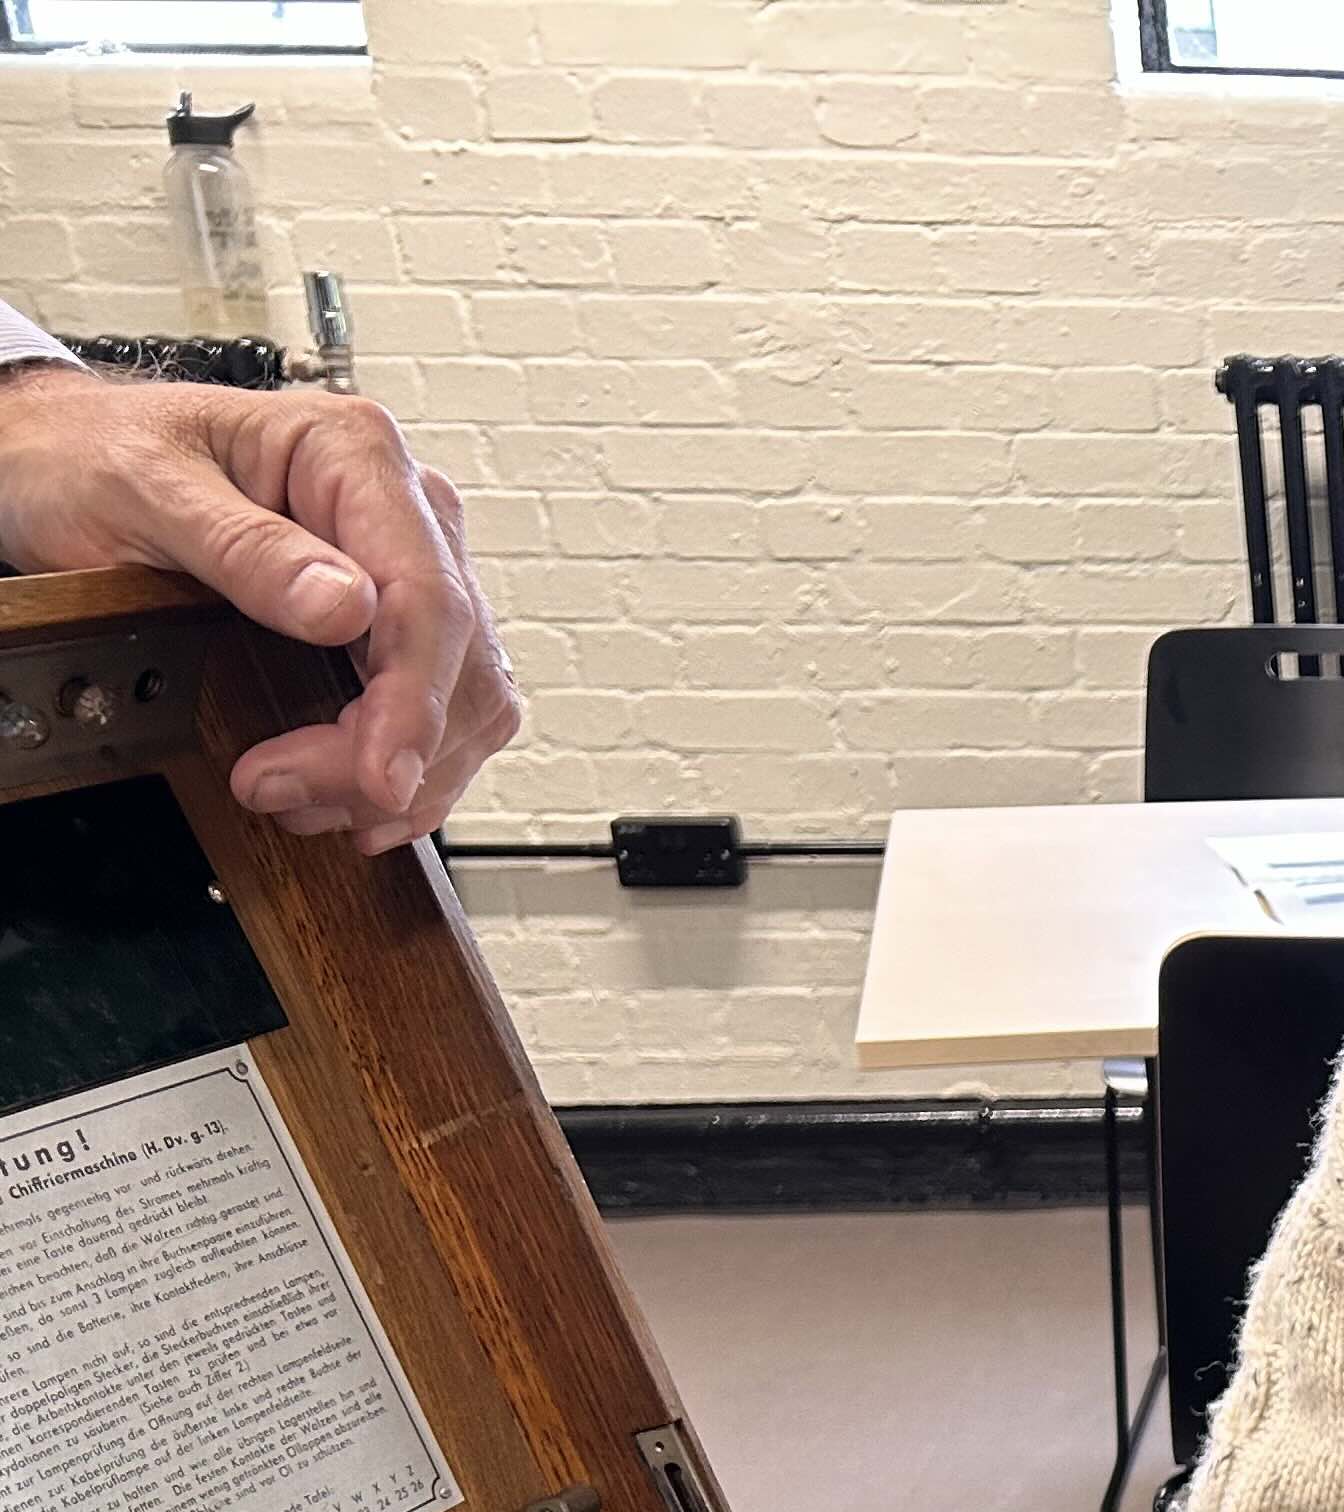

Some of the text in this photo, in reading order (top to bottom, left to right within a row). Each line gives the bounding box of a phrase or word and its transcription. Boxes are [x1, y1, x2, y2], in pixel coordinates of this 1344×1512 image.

[7, 1150, 138, 1200] Chiffriermaschine
[140, 1139, 164, 1160] (H.
[162, 1135, 189, 1150] Dv.
[189, 1129, 205, 1145] g.
[40, 1189, 183, 1245] Einschaltung des Stromes
[15, 1221, 125, 1271] eine Taste dauernd
[1, 1256, 161, 1323] sind bis zum Anschlag ihre
[58, 1298, 89, 1318] sonst
[103, 1277, 149, 1300] Lampen
[6, 1350, 22, 1363] so
[25, 1335, 52, 1355] sind
[55, 1328, 75, 1343] die
[30, 1367, 79, 1392] Lampen
[81, 1352, 108, 1372] nicht
[153, 1323, 177, 1343] sind
[140, 1350, 160, 1364] die
[10, 1358, 181, 1436] die Arbeitskontakte unter den
[142, 1375, 181, 1395] Tasten
[187, 1366, 201, 1379] zu
[177, 1379, 203, 1399] auch
[203, 1368, 233, 1387] Ziffer
[126, 1427, 147, 1441] die
[153, 1448, 172, 1467] auf
[170, 1442, 276, 1497] Die Kontakte
[121, 1480, 160, 1503] halten
[163, 1464, 186, 1484] und
[331, 1501, 342, 1512] V
[349, 1489, 363, 1504] W
[370, 1481, 382, 1495] X
[388, 1472, 397, 1485] Y
[404, 1463, 415, 1477] Z
[375, 1495, 392, 1512] 24
[393, 1485, 410, 1502] 25
[408, 1478, 425, 1493] 26
